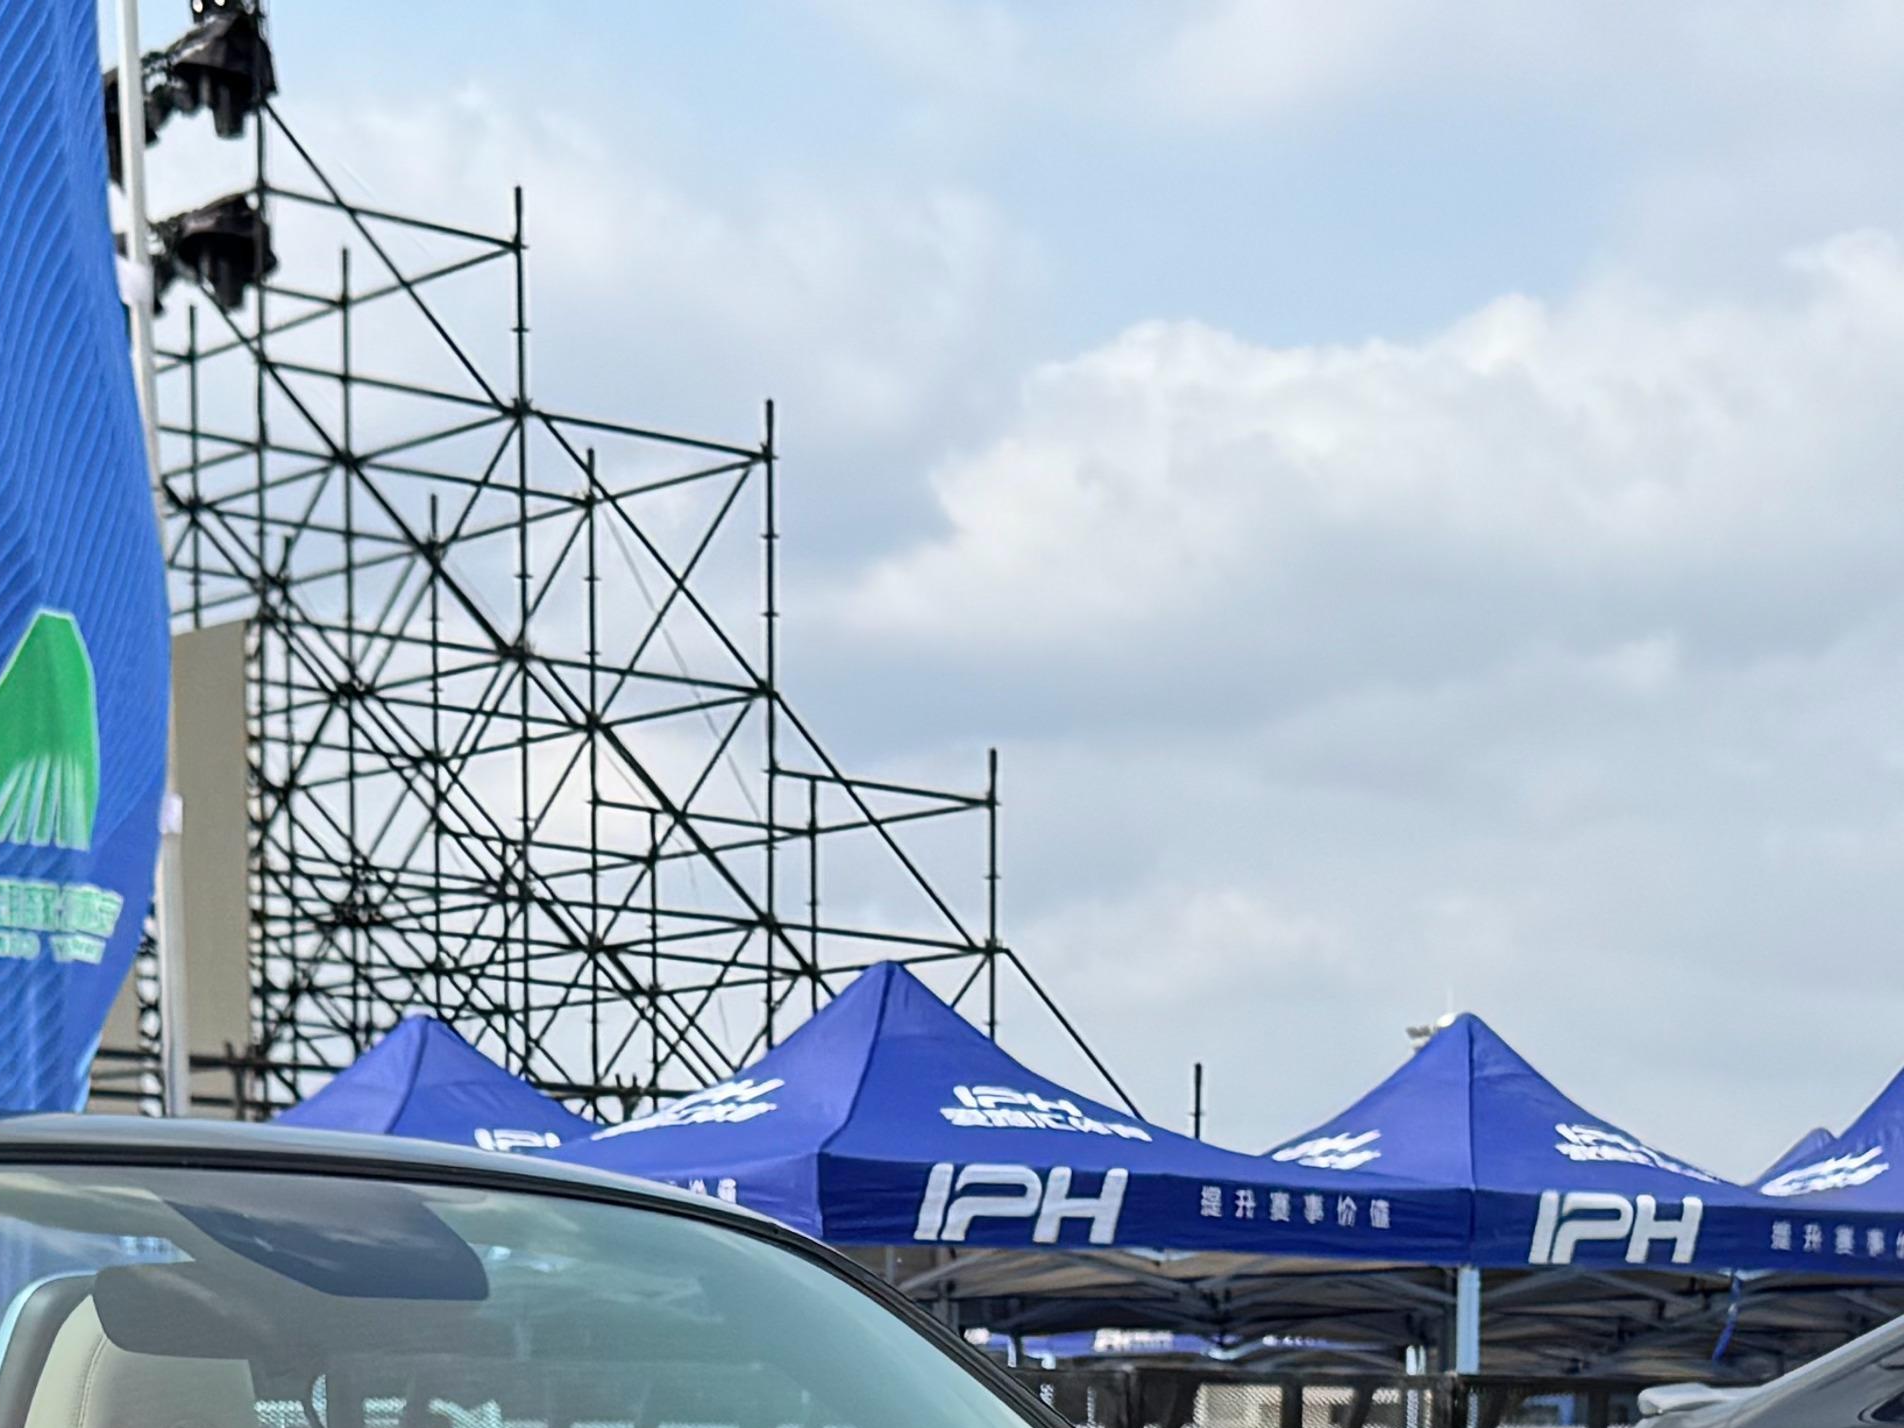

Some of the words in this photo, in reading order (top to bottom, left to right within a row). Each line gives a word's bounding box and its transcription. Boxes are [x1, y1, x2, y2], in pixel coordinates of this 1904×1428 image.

[953, 1085, 1083, 1117] IPH
[913, 1163, 1129, 1244] IPH
[1528, 1189, 1704, 1264] IPH
